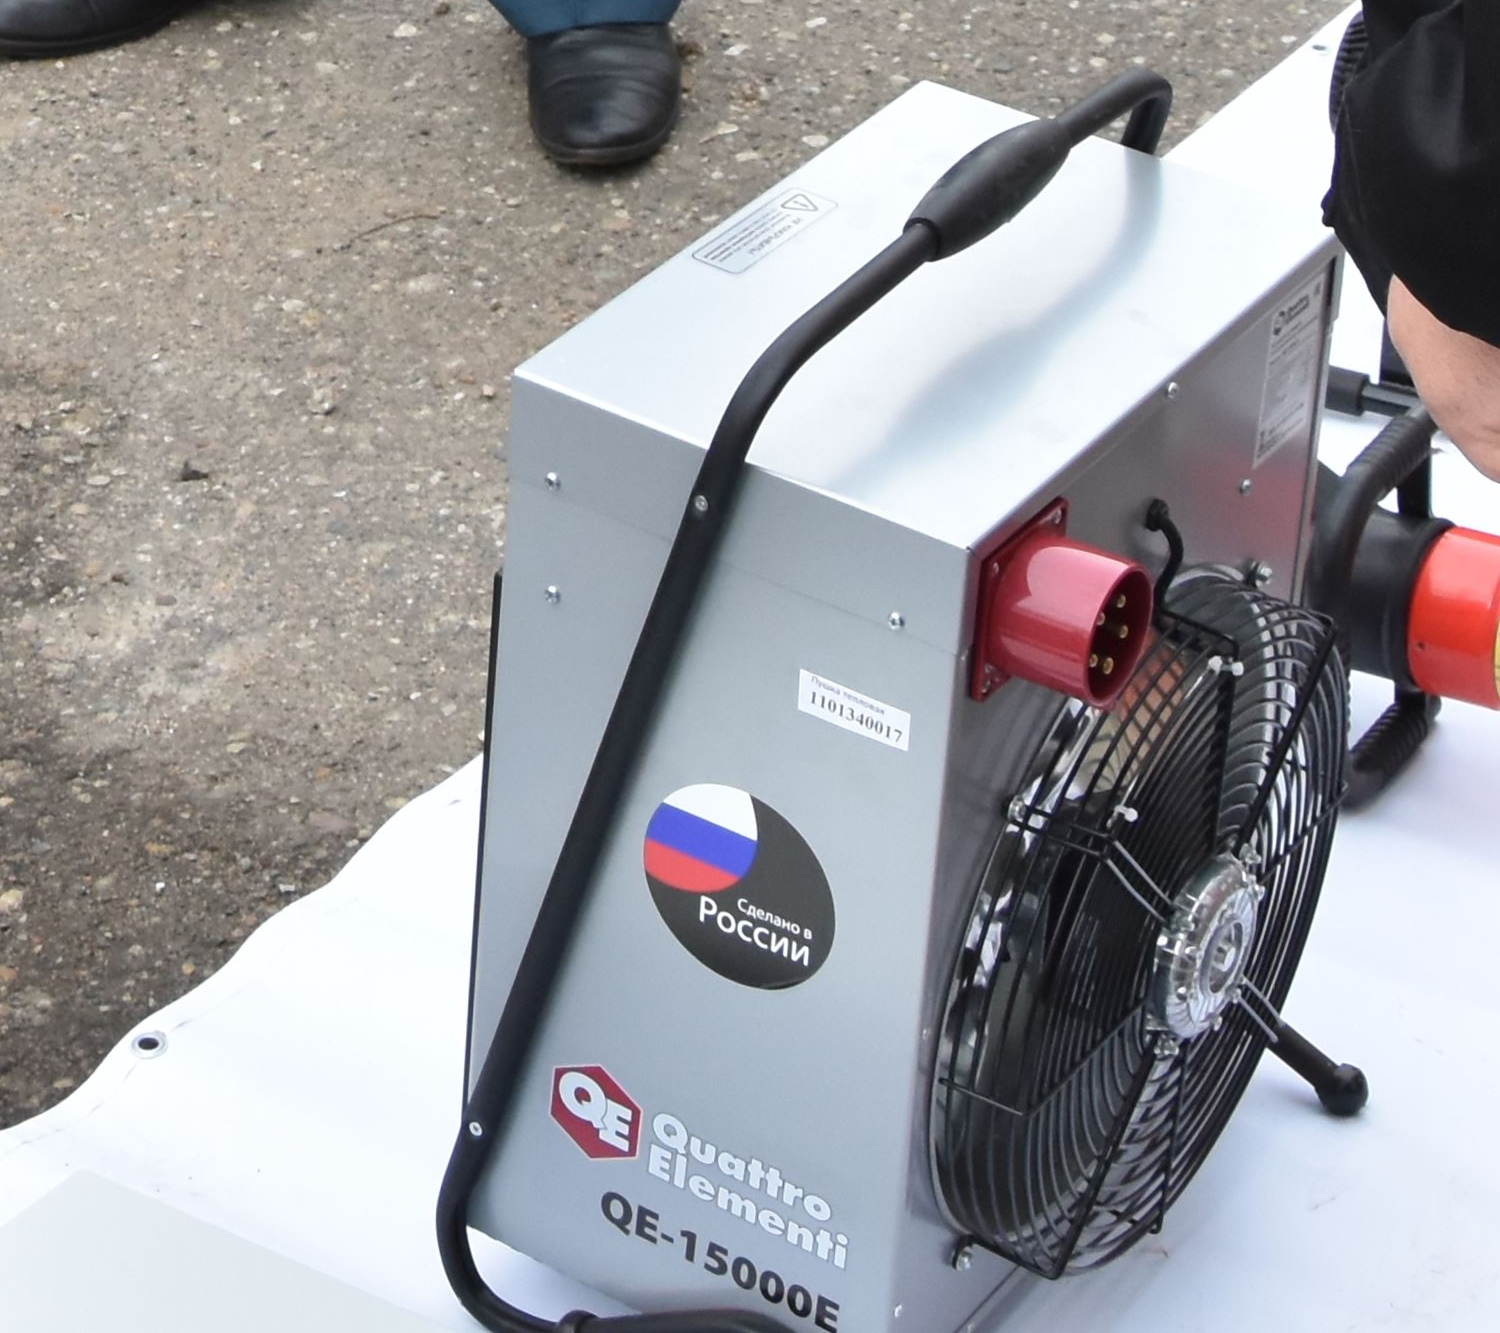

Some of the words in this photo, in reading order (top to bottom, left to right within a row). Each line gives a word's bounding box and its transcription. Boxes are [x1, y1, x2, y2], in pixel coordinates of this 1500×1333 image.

[810, 691, 902, 743] 1101340017
[737, 898, 800, 935] Сделано
[803, 928, 814, 941] в
[558, 1071, 633, 1153] QE
[648, 1143, 849, 1270] Elementi
[651, 1112, 832, 1222] Quattro
[600, 1190, 841, 1333] QE-15000E
